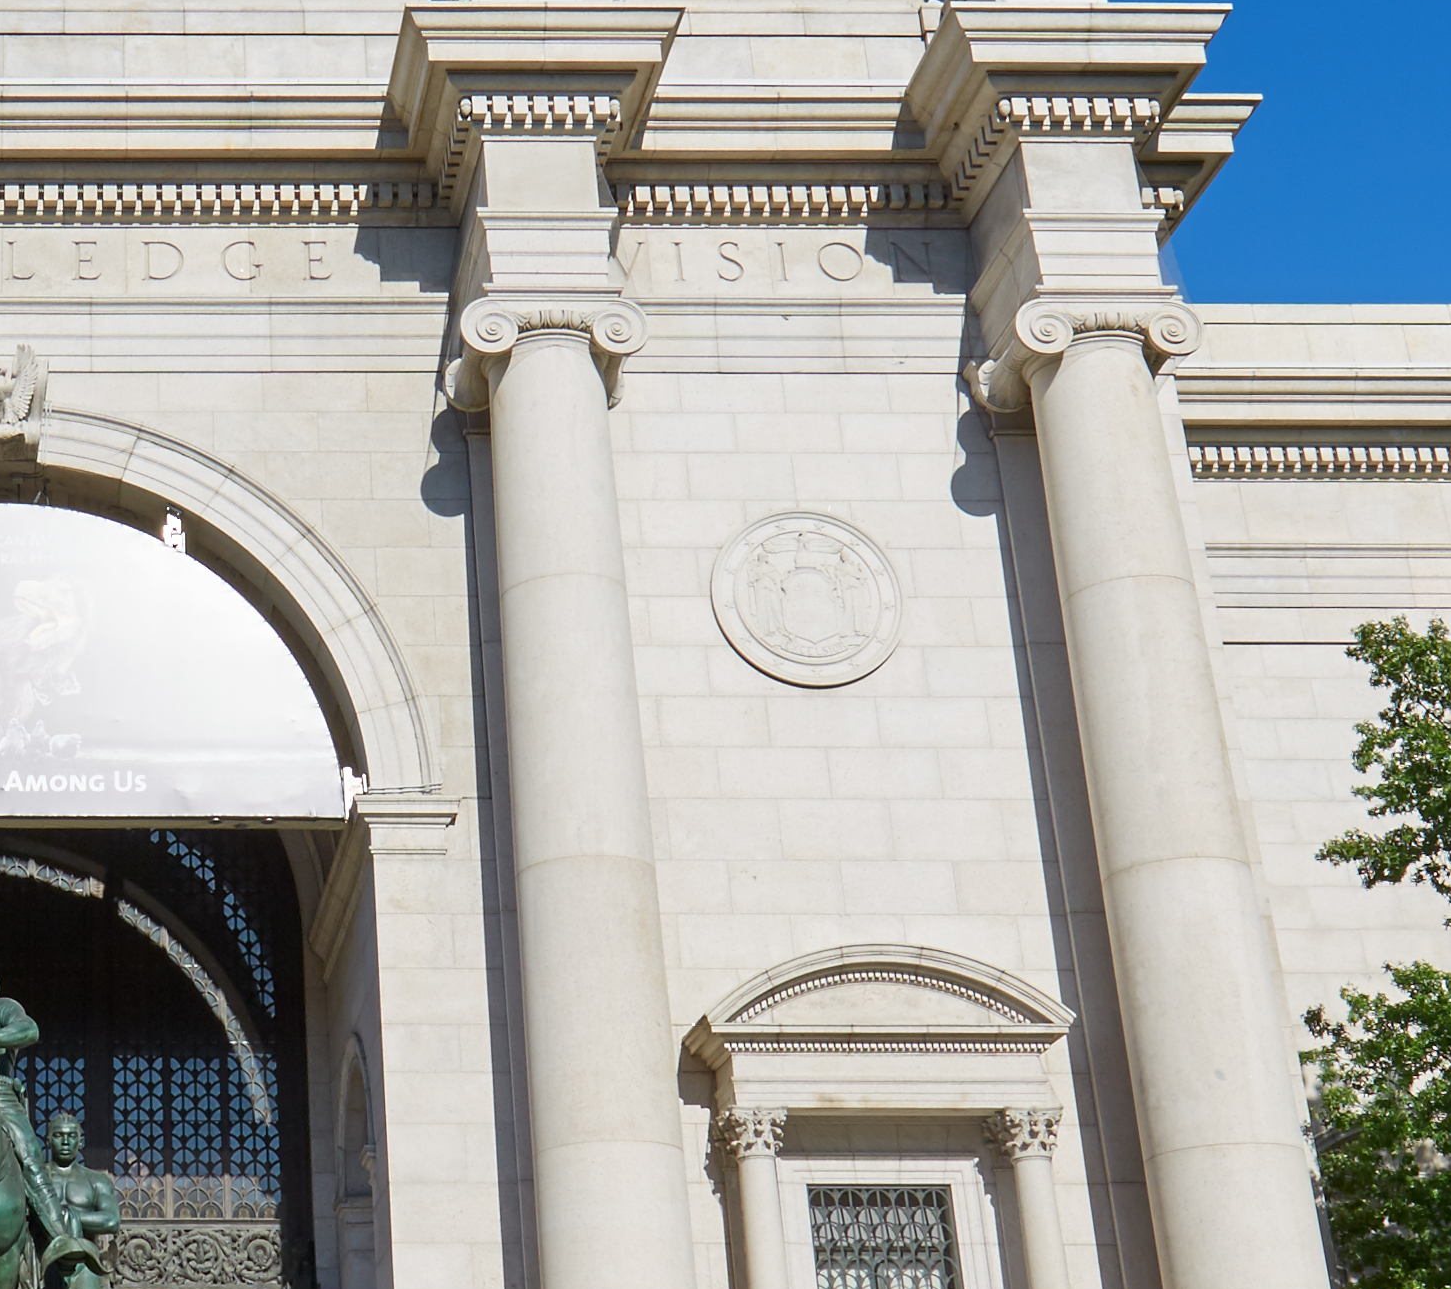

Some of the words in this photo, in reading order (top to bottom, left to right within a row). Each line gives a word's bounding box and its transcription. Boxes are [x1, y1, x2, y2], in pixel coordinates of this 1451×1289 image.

[613, 241, 934, 282] VISION
[783, 641, 846, 656] EXCELSIOR
[4, 769, 105, 792] AMONG
